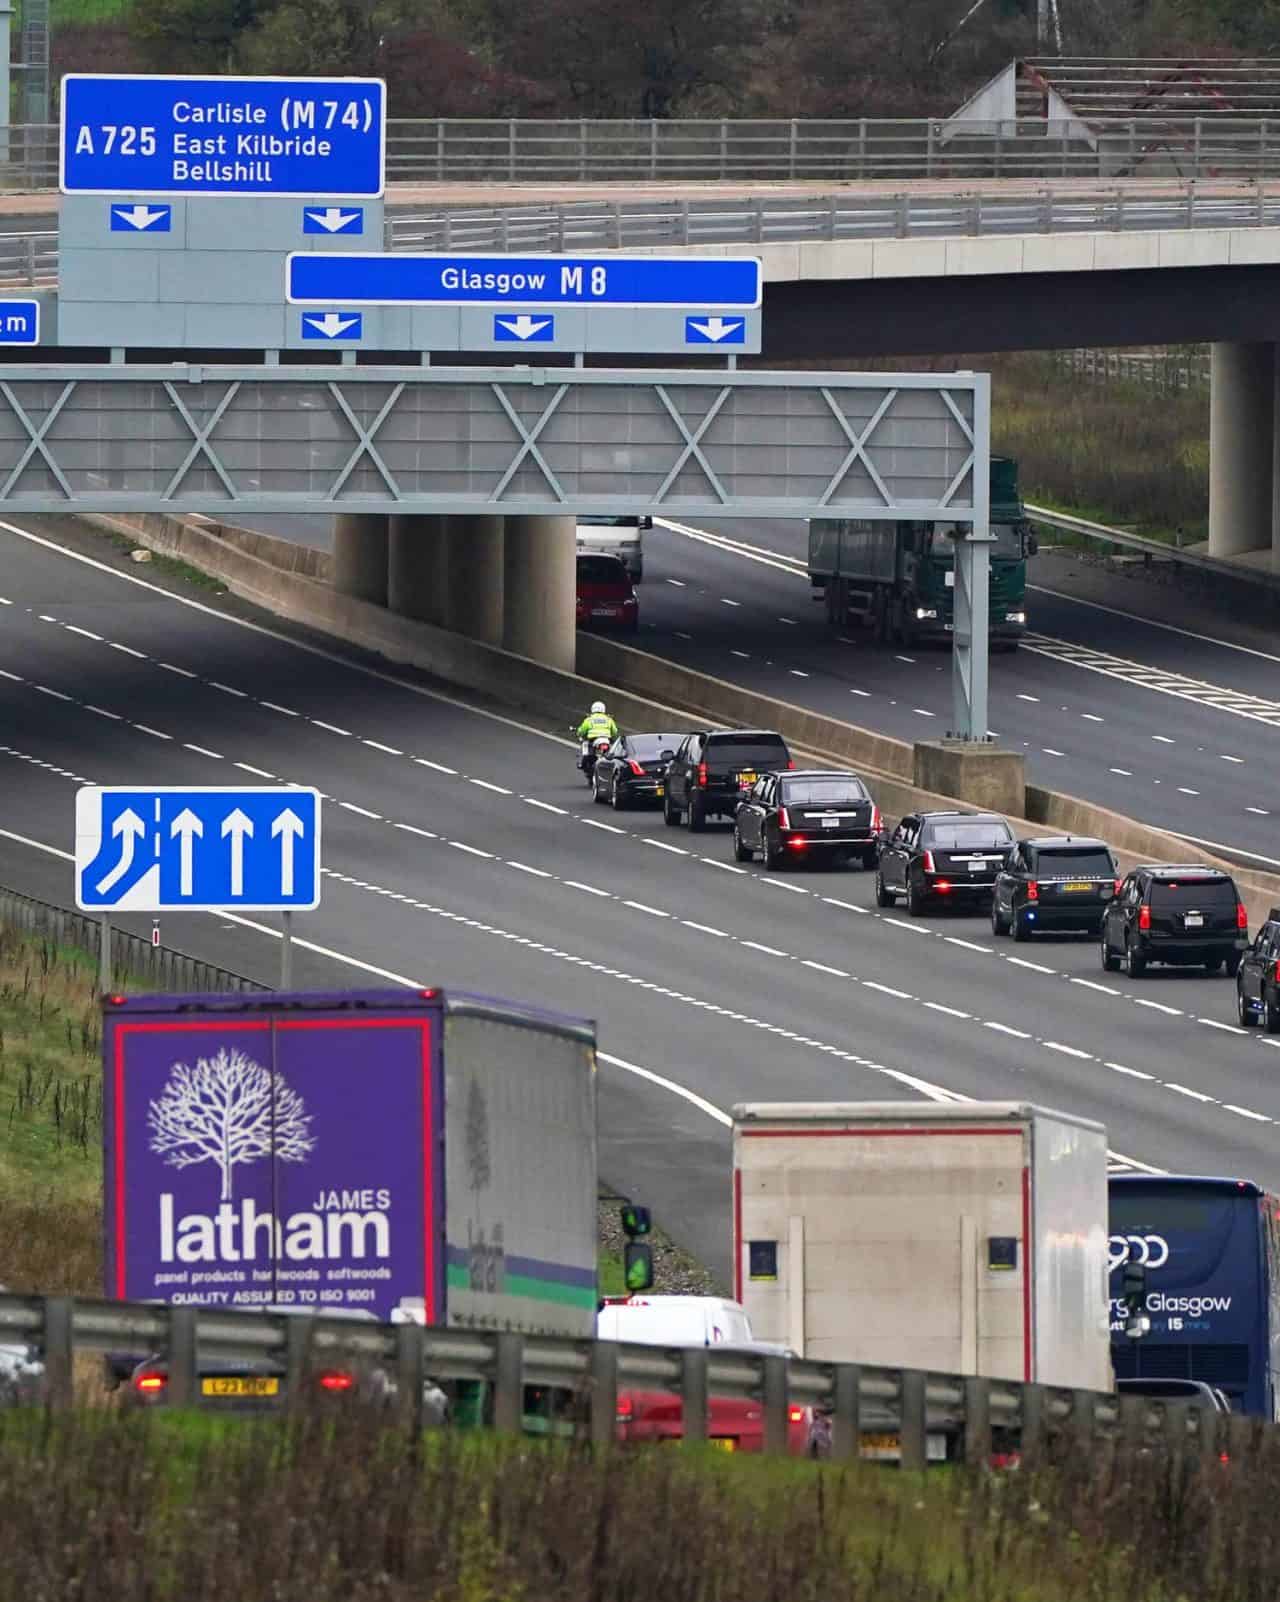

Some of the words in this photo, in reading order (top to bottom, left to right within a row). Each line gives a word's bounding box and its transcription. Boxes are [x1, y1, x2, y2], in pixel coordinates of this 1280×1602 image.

[172, 102, 267, 124] Carlisle
[172, 134, 227, 155] East
[237, 134, 331, 157] Kilbride
[172, 160, 273, 182] Bellshill
[440, 267, 546, 294] Glasgow
[313, 1189, 391, 1210] JAMES
[159, 1192, 391, 1263] latham
[154, 1270, 188, 1286] panel
[191, 1269, 246, 1286] products
[327, 1266, 392, 1280] softwoods
[171, 1290, 230, 1305] QUALITY
[298, 1288, 317, 1302] TO
[319, 1288, 344, 1302] ISO
[1145, 1292, 1231, 1317] Glasgow
